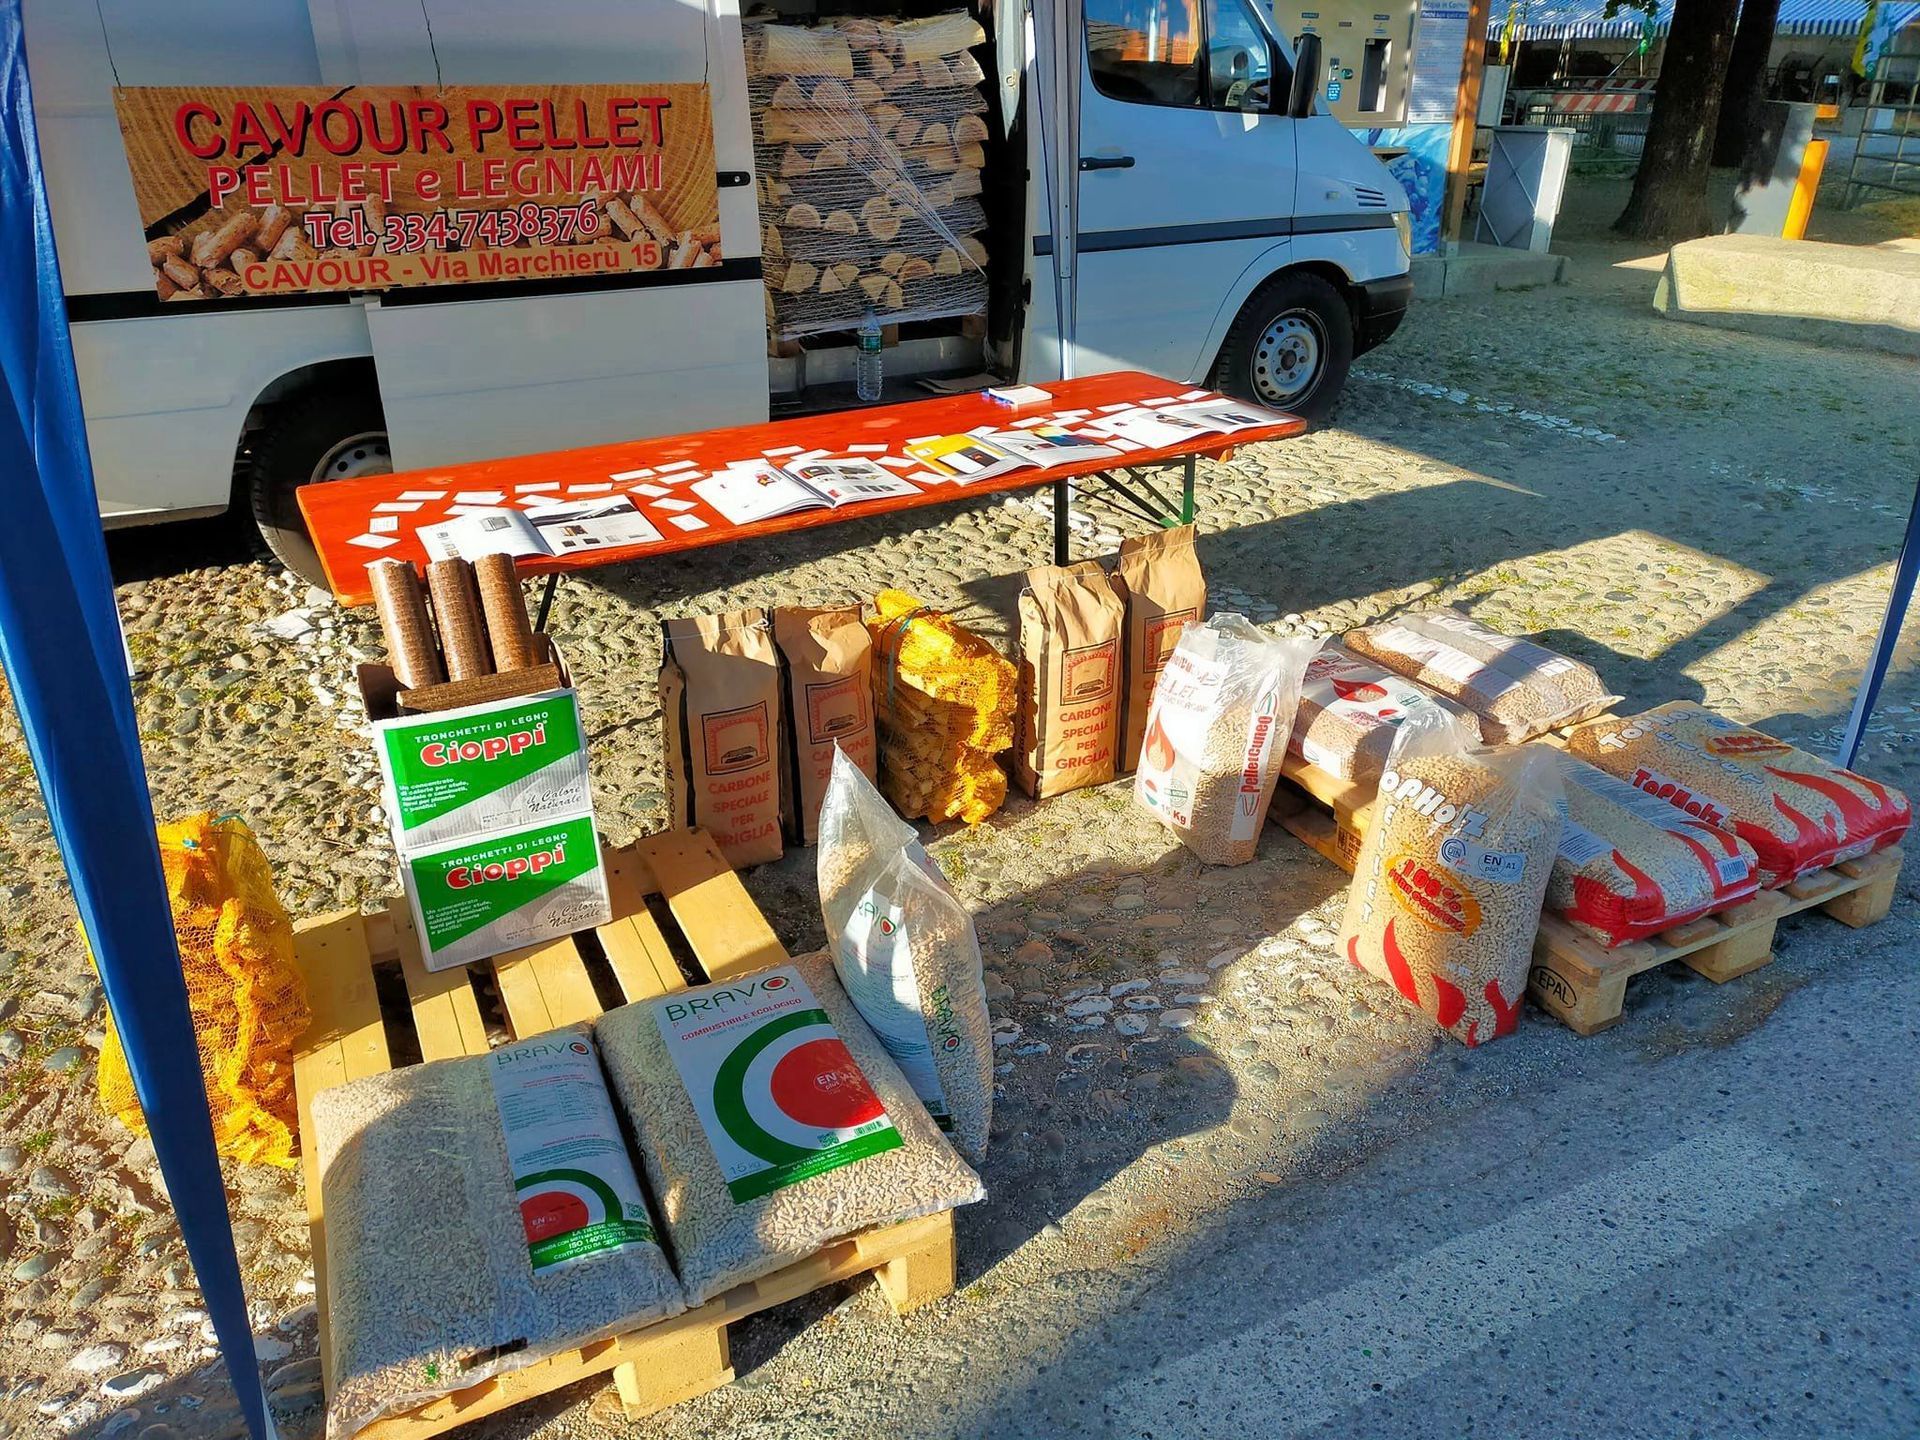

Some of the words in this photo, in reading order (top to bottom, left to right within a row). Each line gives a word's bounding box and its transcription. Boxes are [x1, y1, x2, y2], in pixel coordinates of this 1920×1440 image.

[174, 99, 451, 159] CAVOUR
[467, 96, 671, 154] PELLET
[207, 161, 400, 208] PELLET
[414, 171, 442, 200] e
[456, 154, 664, 200] LEGNAMI
[304, 210, 378, 249] Tel.
[383, 200, 601, 253] 334.7438376
[244, 260, 391, 291] CAVOUR
[420, 253, 470, 280] Via
[477, 246, 621, 275] Marchierù
[631, 243, 658, 267] 15
[1059, 702, 1112, 723] CARBONE
[415, 724, 492, 744] TRONCHETTI
[495, 720, 508, 729] DI
[511, 711, 549, 726] LEGNO
[1062, 721, 1109, 739] SPECIALE
[420, 721, 547, 767] Cioppi
[812, 736, 871, 762] CAONE
[1077, 739, 1097, 751] PER
[1055, 747, 1111, 770] GRIGLIA
[541, 786, 580, 802] Calore
[708, 770, 772, 794] CARBONE
[528, 795, 582, 813] Naturale
[712, 791, 770, 813] SPECIALE
[731, 813, 754, 828] PER
[1173, 810, 1187, 826] Kg
[441, 846, 513, 869] TRONCHETTI
[516, 840, 528, 850] DI
[531, 832, 568, 848] LEGNO
[1484, 854, 1502, 866] EN
[446, 842, 566, 890] Cioppi
[1403, 858, 1462, 913] 100%
[549, 909, 600, 928] Naturale
[561, 901, 599, 917] Calore
[664, 974, 791, 1023] BRAVO
[1537, 968, 1569, 1006] EPAL
[681, 1012, 751, 1042] COMBUSTIBILE
[751, 998, 802, 1019] ECOLOGICO
[497, 1041, 590, 1066] BRAVO
[816, 1072, 837, 1085] EN
[569, 1240, 584, 1250] ISO
